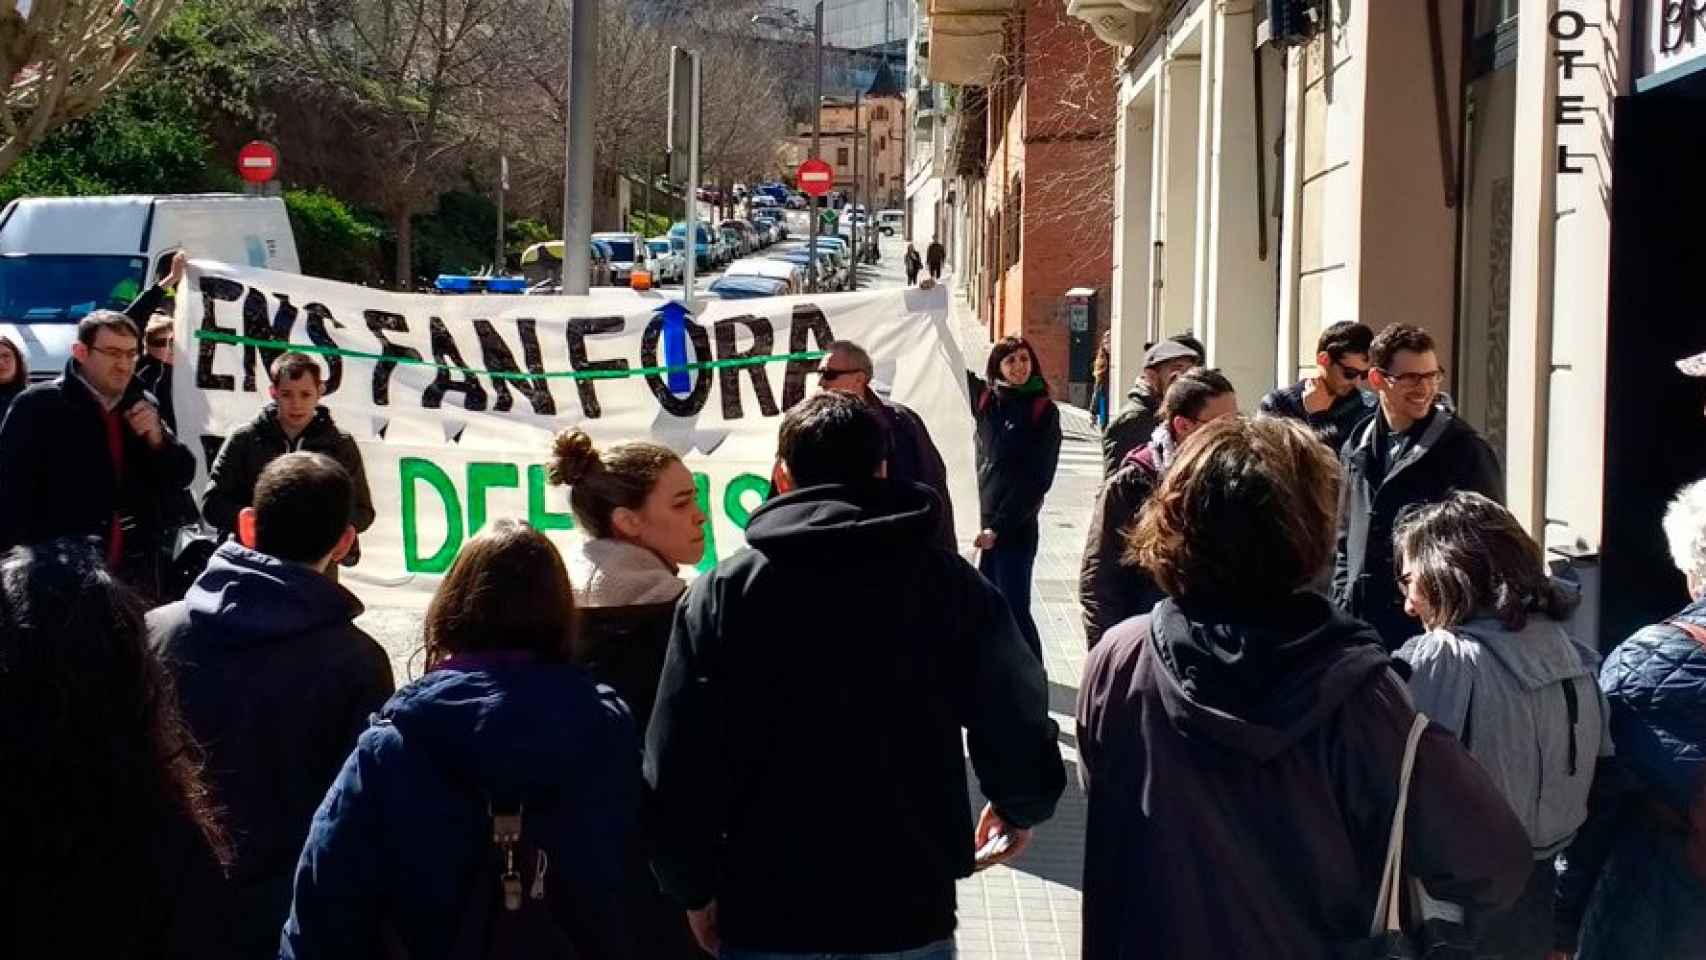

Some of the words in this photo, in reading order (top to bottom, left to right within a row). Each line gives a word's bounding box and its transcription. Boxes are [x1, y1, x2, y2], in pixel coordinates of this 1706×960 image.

[195, 275, 345, 396] ENS
[364, 309, 556, 416] FAN
[567, 303, 836, 420] FORA
